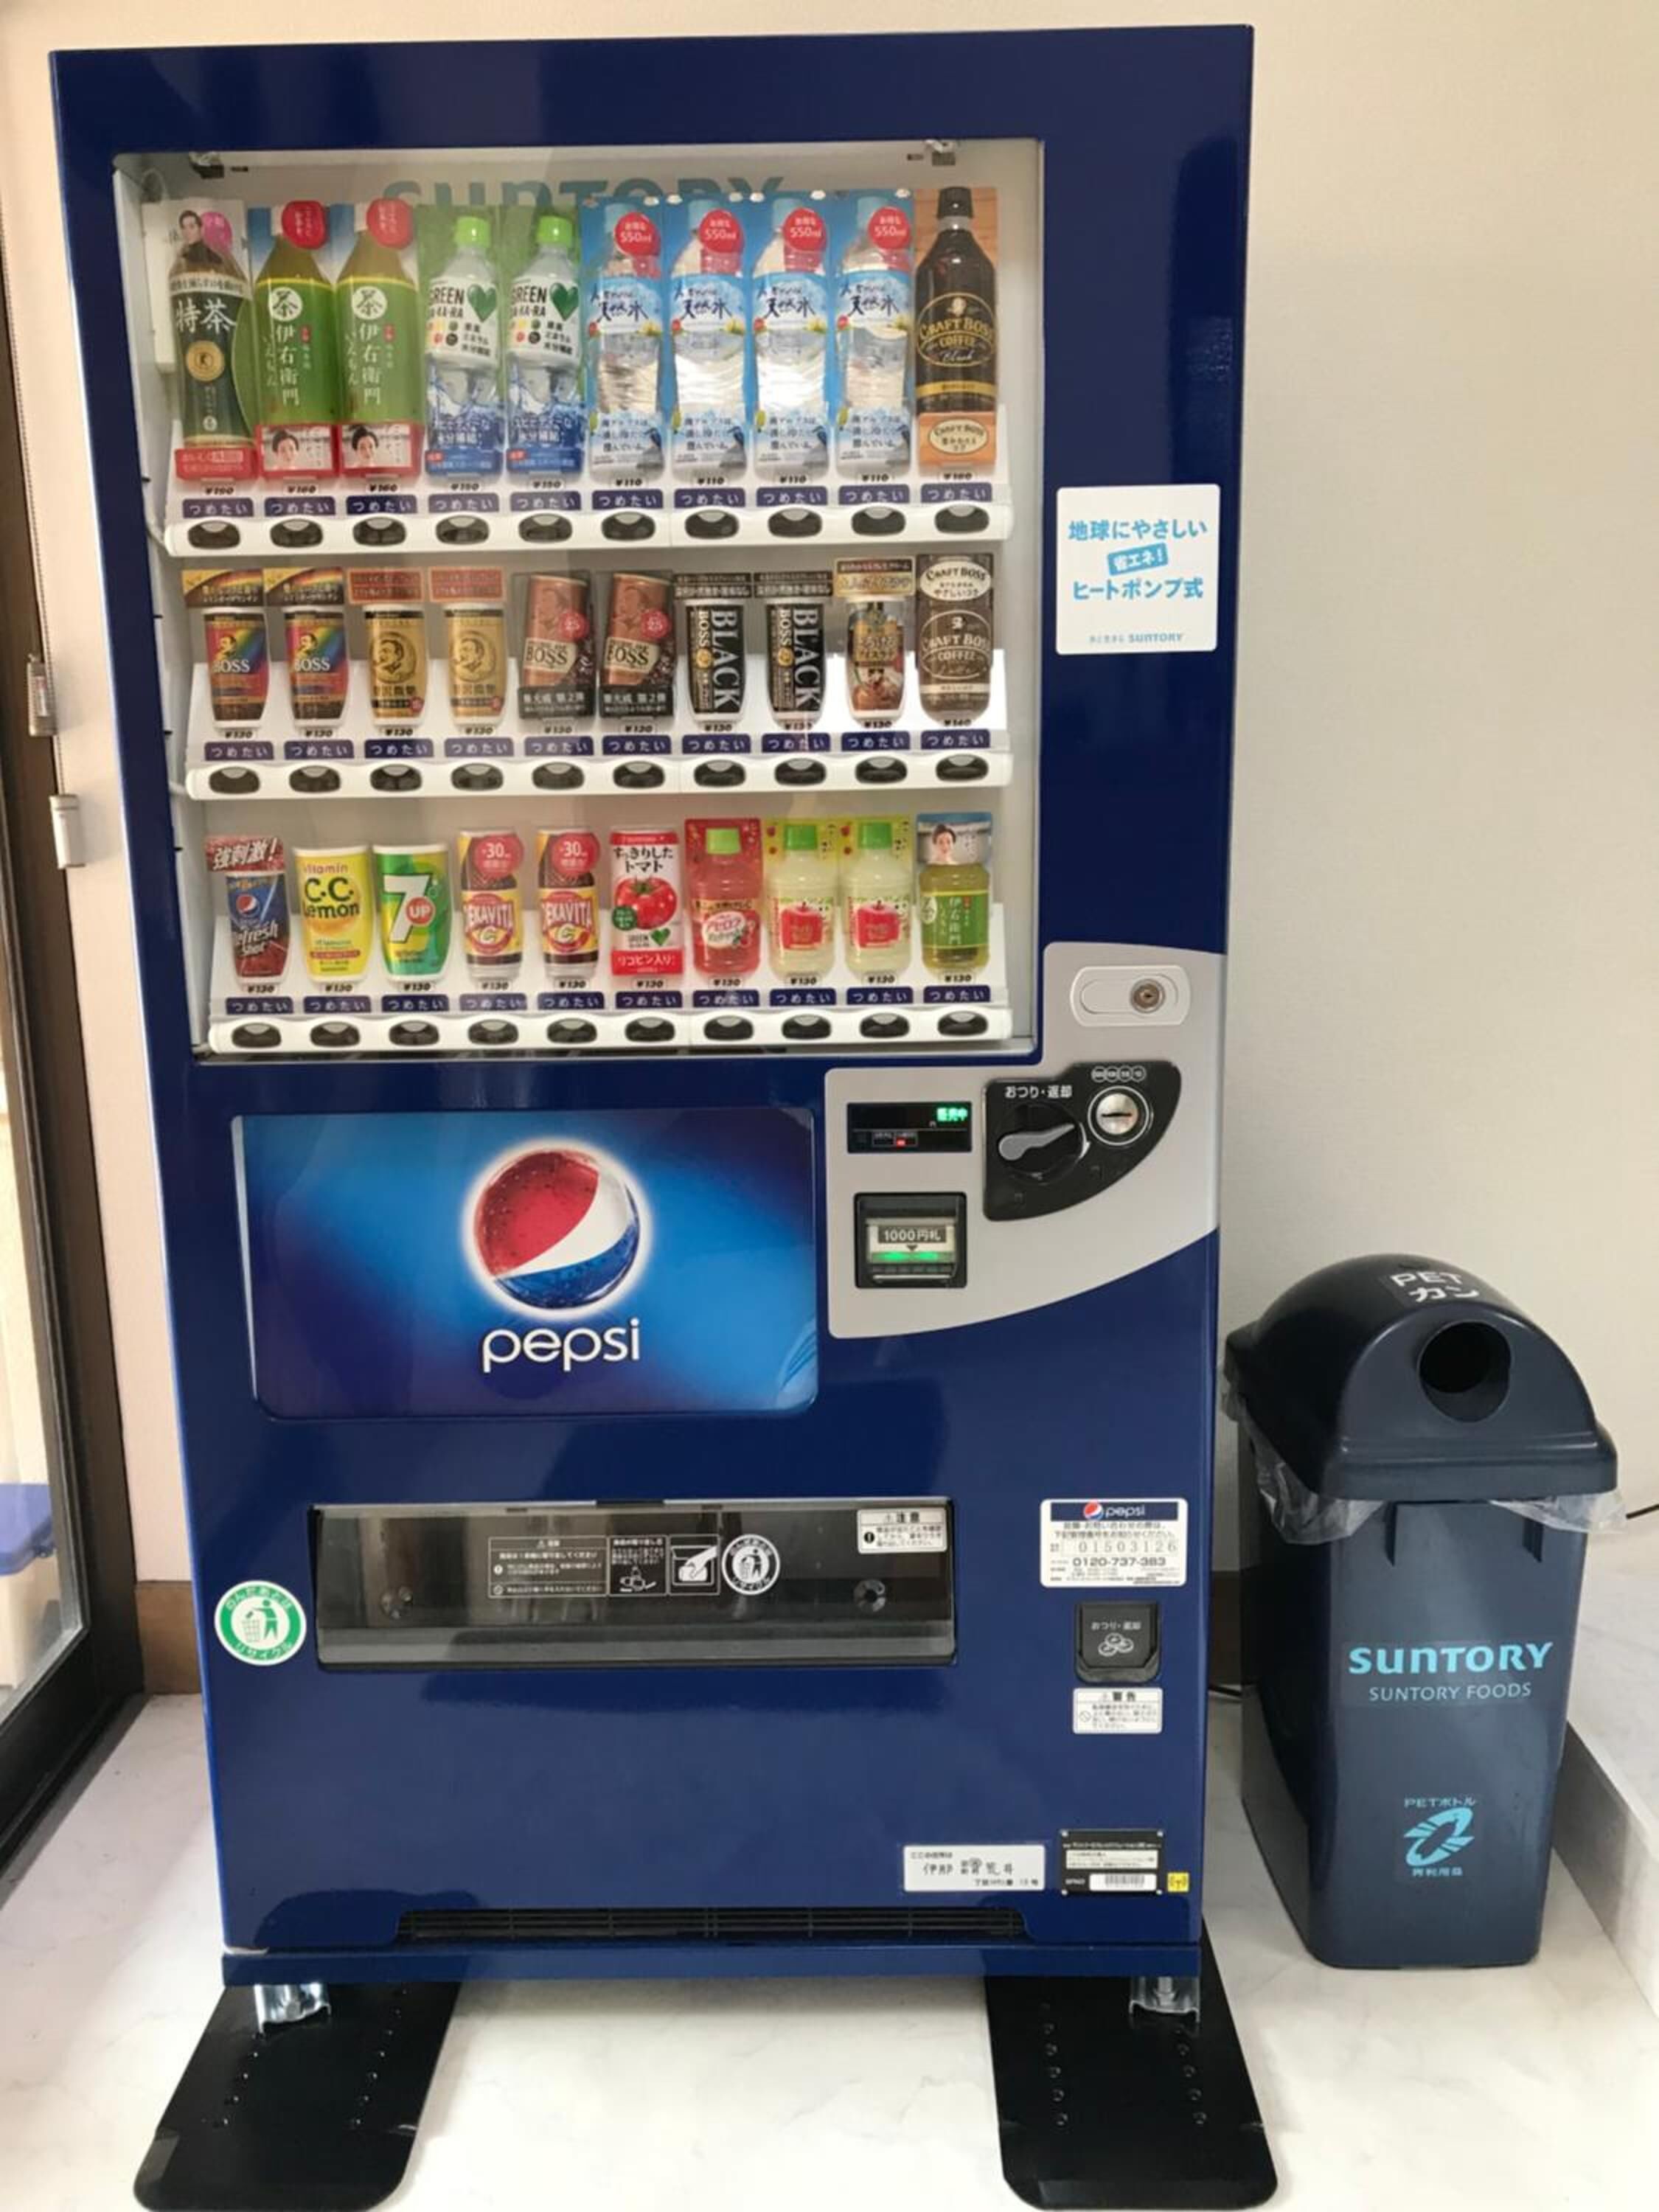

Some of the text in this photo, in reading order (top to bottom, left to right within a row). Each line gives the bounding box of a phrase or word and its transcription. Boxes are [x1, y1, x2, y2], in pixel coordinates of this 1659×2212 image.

[620, 230, 653, 243] 550ml
[705, 228, 737, 241] 550ml
[790, 226, 822, 239] 550ml
[874, 226, 907, 237] 550ml
[272, 290, 299, 319] 茶
[356, 288, 383, 316] 茶
[764, 296, 816, 319] 天然水
[848, 295, 900, 317] 天然水
[176, 296, 237, 333] 特茶
[597, 299, 649, 323] 天然水
[681, 298, 733, 321] 天然水
[920, 319, 963, 338] CRAFT
[939, 336, 976, 349] COFFEE
[276, 324, 300, 406] 伊右衛門
[359, 323, 381, 406] 伊右衛門
[779, 475, 807, 484] ¥110
[861, 473, 890, 483] ¥110
[681, 494, 740, 506] つめたい
[763, 493, 821, 505] つめたい
[846, 491, 904, 504] つめたい
[928, 488, 987, 500] つめたい
[352, 500, 411, 512] つめたい
[436, 498, 493, 510] つめたい
[518, 497, 576, 508] つめたい
[599, 495, 657, 507] つめたい
[189, 503, 248, 515] つめたい
[271, 502, 330, 514] つめたい
[1068, 519, 1208, 541] 地球にやさしい
[1073, 577, 1204, 600] ヒートポンプ式
[698, 610, 711, 647] BOSS
[779, 608, 792, 647] BOSS
[1128, 633, 1183, 644] SUNTORY
[525, 641, 568, 664] BOSS
[607, 641, 650, 665] BOSS
[793, 609, 821, 709] BLACK
[711, 610, 740, 709] BLACK
[609, 740, 666, 752] つめたい
[688, 740, 745, 751] つめたい
[768, 738, 825, 750] つめたい
[848, 737, 905, 748] つめたい
[927, 734, 984, 747] つめたい
[211, 746, 268, 757] つめたい
[291, 745, 348, 757] つめたい
[371, 744, 428, 756] つめたい
[451, 743, 509, 754] つめたい
[530, 742, 588, 753] つめたい
[613, 846, 673, 860] すっきりした
[625, 860, 664, 873] トマト
[304, 876, 355, 903] C.C.
[409, 905, 431, 918] UP
[543, 997, 601, 1008] つめたい
[622, 995, 679, 1007] つめたい
[699, 994, 755, 1005] つめたい
[775, 992, 832, 1004] つめたい
[852, 991, 908, 1003] つめたい
[928, 990, 985, 1002] つめたい
[232, 1001, 289, 1012] つめたい
[310, 1000, 367, 1012] つめたい
[388, 999, 445, 1011] つめたい
[465, 998, 523, 1009] つめたい
[1004, 1085, 1072, 1099] おつり・返却
[884, 1228, 942, 1242] 1000円札
[1389, 1270, 1464, 1287] PET
[1408, 1285, 1480, 1303] カン
[482, 1317, 641, 1374] pepsi
[1106, 1504, 1145, 1519] pepsi
[1077, 1540, 1178, 1554] 01503126
[1072, 1557, 1166, 1567] 0120-737-383
[1348, 1641, 1554, 1674] SUNTORY
[1368, 1681, 1532, 1702] SUNTORY FOODS
